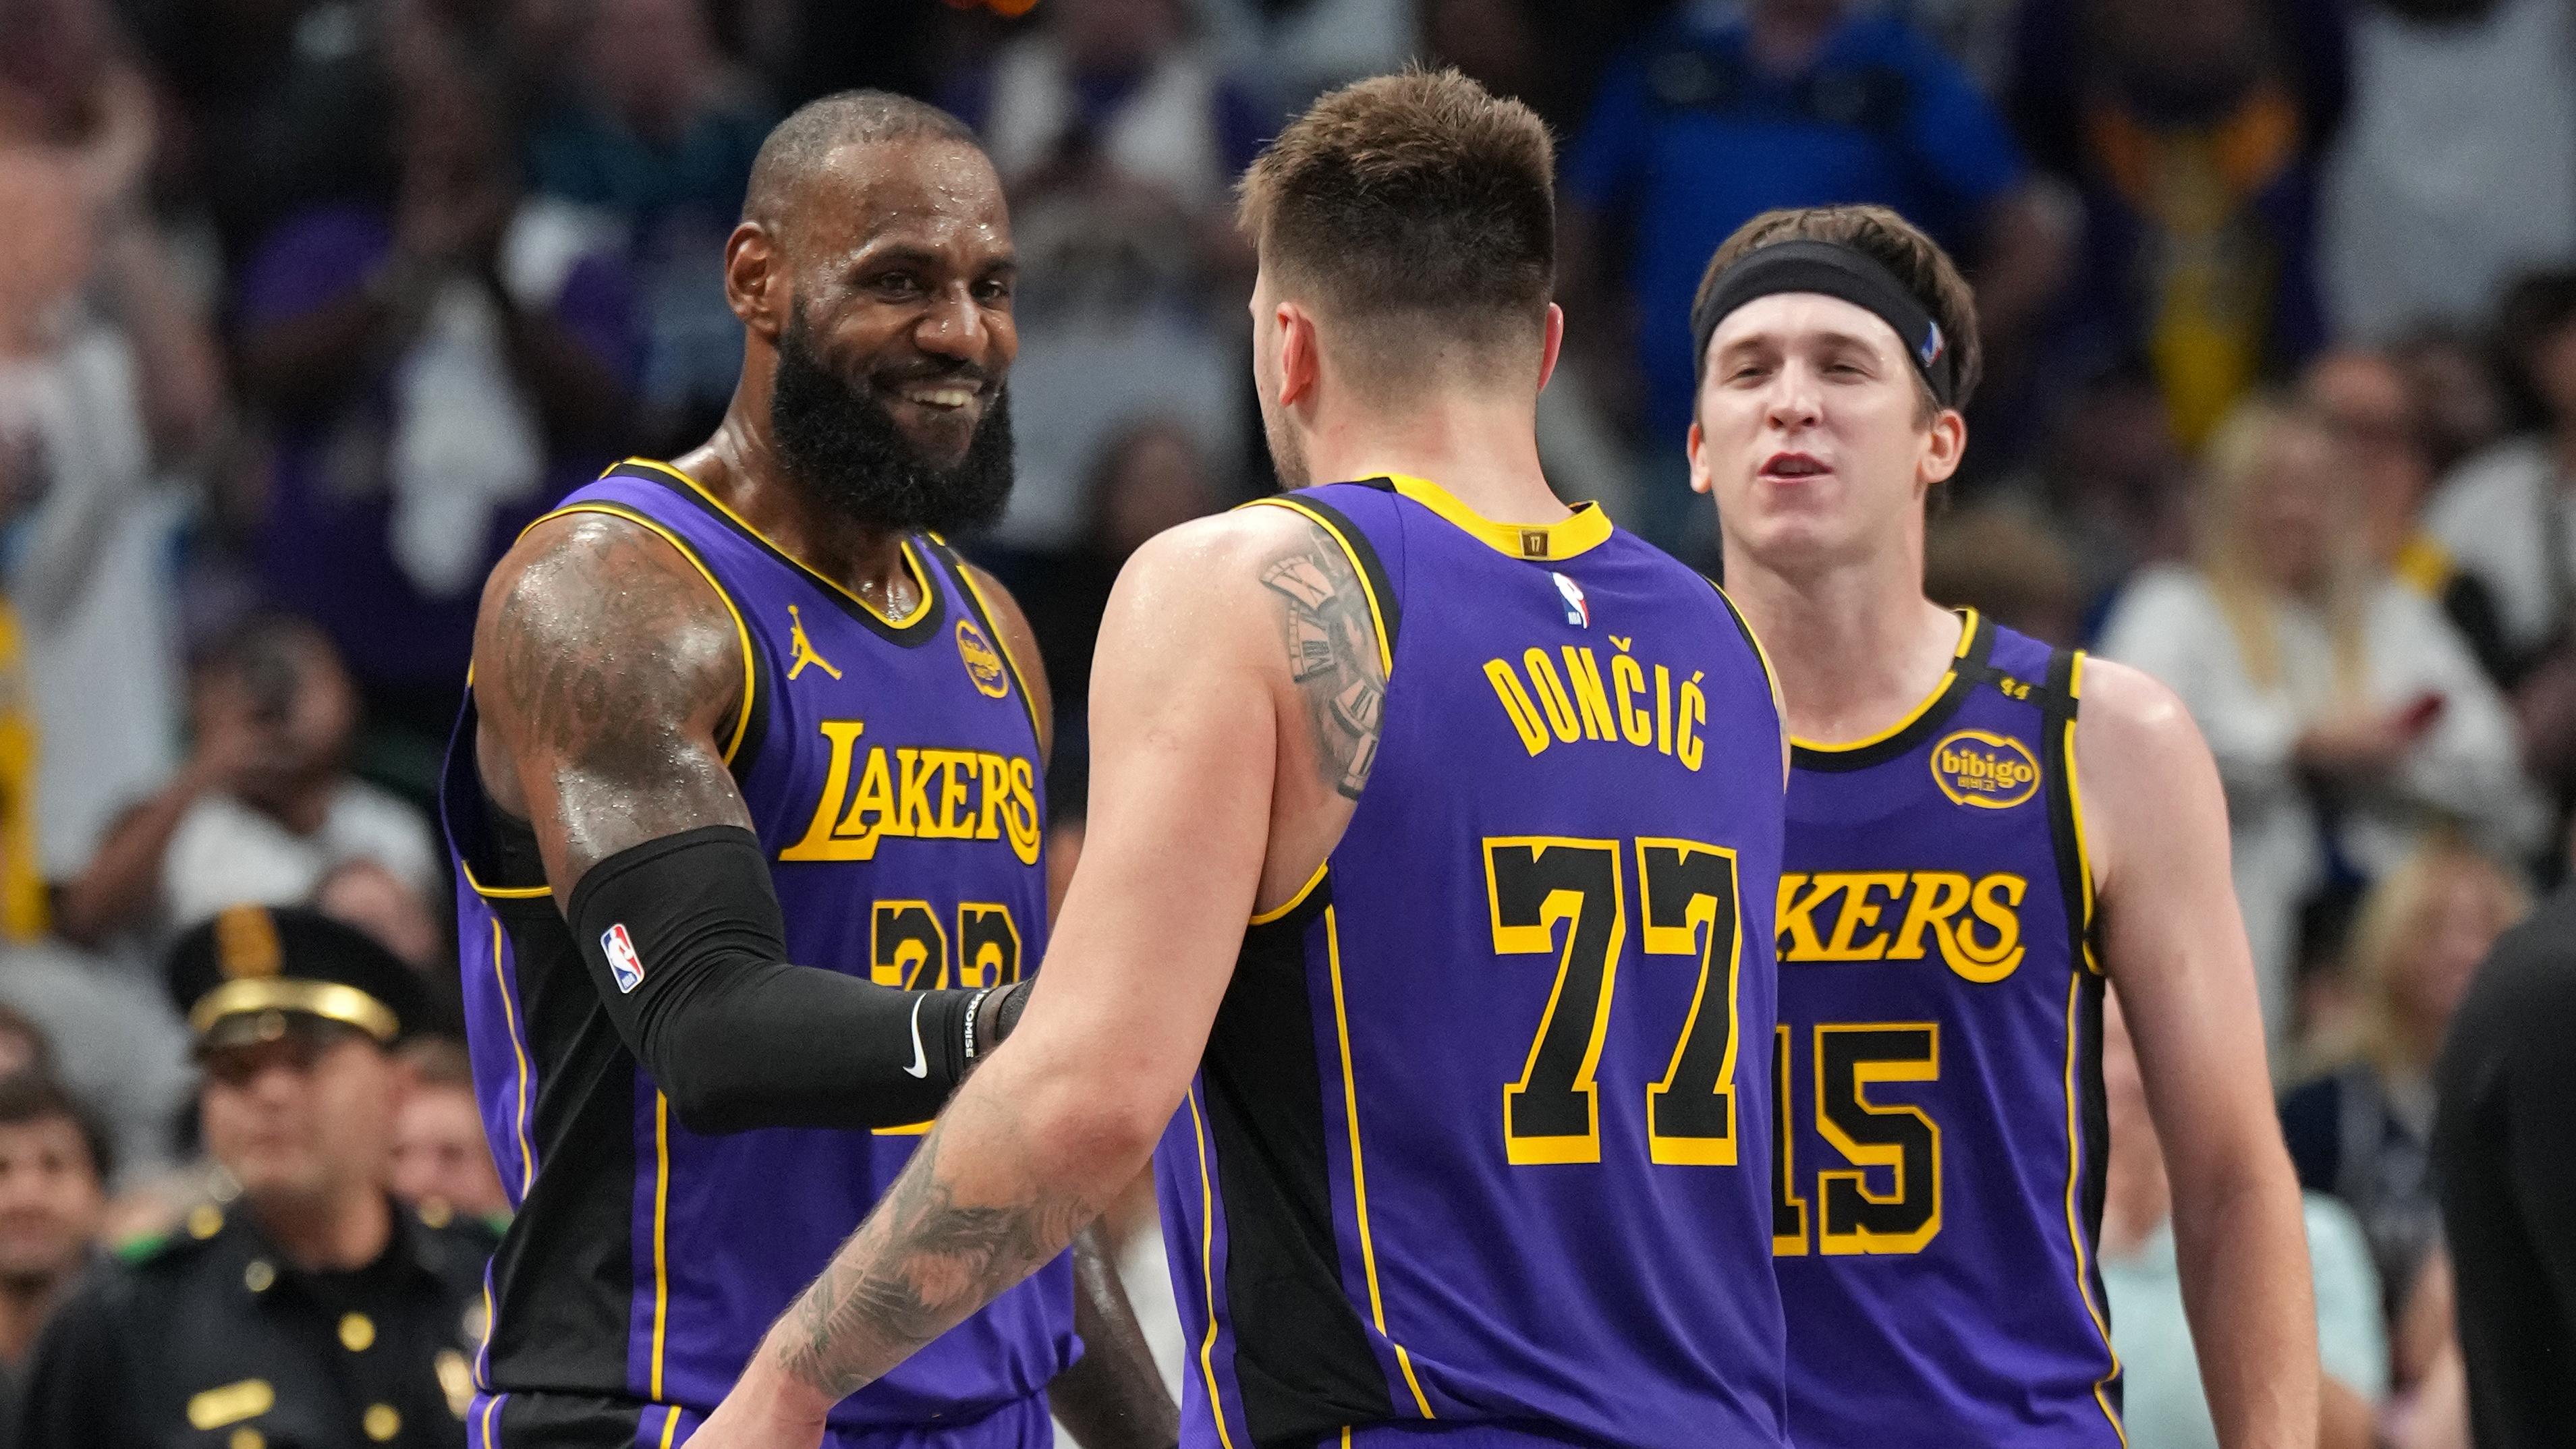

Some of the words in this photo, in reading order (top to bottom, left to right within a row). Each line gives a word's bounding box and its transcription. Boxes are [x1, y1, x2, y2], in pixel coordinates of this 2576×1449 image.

[1482, 634, 1706, 772] DONČIĆ
[1942, 747, 2033, 789] bibigo
[779, 719, 1041, 865] LAKERS
[1482, 835, 1743, 1166] 77
